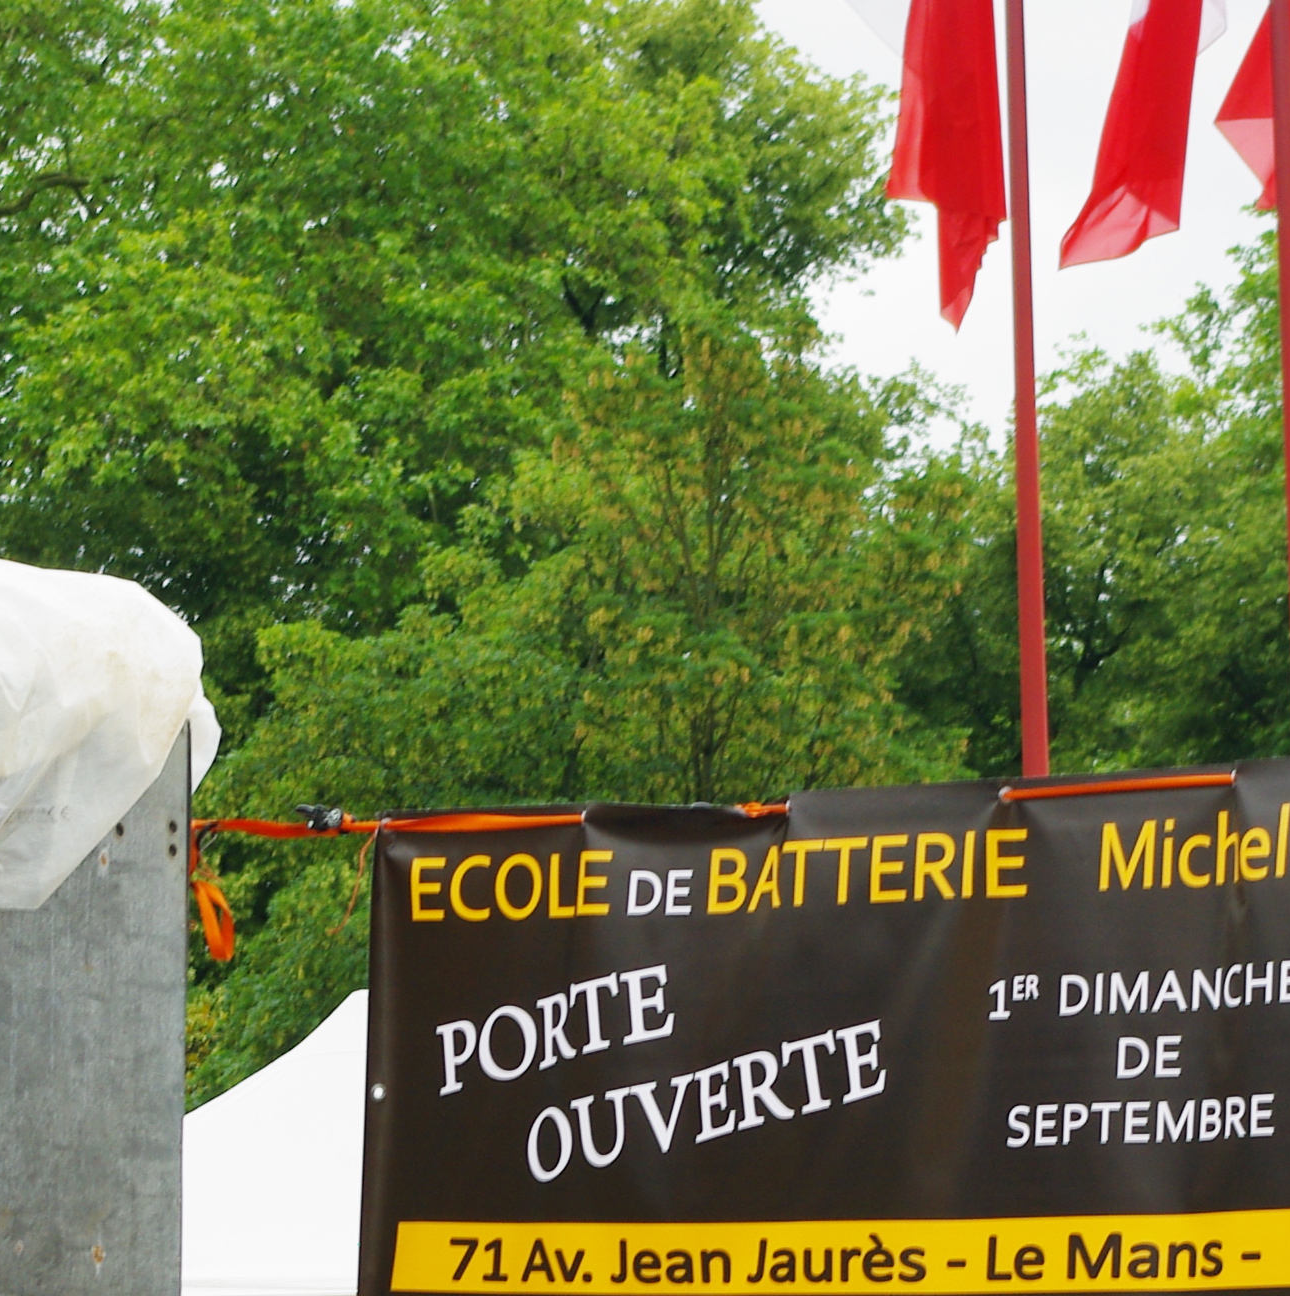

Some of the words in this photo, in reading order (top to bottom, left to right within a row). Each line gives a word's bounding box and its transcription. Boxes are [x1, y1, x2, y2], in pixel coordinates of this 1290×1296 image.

[410, 850, 613, 922] ECOLE
[627, 869, 693, 916] DE
[706, 829, 1028, 915] BATTERIE
[436, 964, 675, 1096] PORTE
[1116, 1035, 1182, 1079] DE
[527, 1020, 887, 1183] OUVERTE
[1006, 1093, 1274, 1148] SEPTEMBRE
[448, 1238, 509, 1282] 71
[521, 1239, 592, 1282] Av.
[610, 1239, 731, 1283] Jean
[747, 1234, 926, 1284] Jaurès
[986, 1236, 1044, 1281] Le
[1066, 1233, 1224, 1279] Mans
